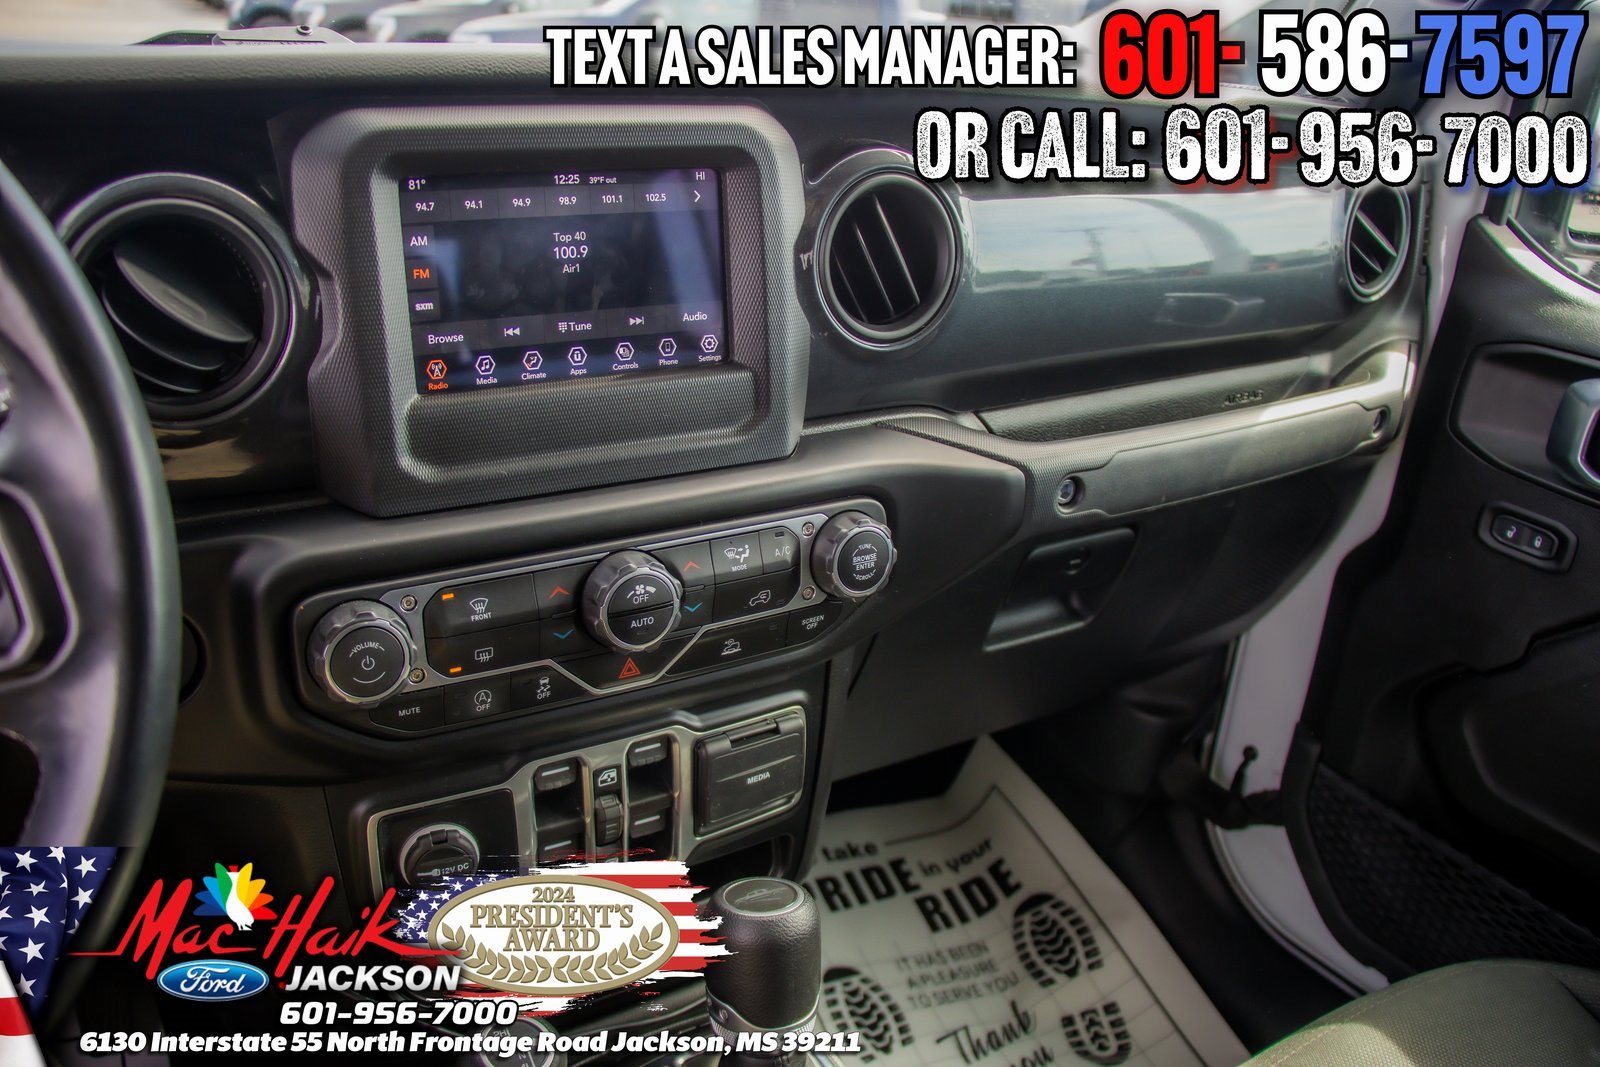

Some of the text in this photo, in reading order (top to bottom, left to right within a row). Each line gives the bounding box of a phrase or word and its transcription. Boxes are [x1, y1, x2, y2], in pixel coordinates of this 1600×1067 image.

[553, 174, 580, 185] 12:25
[605, 176, 617, 184] out
[695, 171, 706, 181] HI
[512, 198, 531, 208] 94.9
[558, 196, 577, 206] 98.9
[602, 194, 623, 204] 101.1
[645, 193, 666, 203] 102.5
[415, 202, 434, 212] 94.7
[464, 200, 483, 210] 94.1
[410, 236, 428, 247] AM
[553, 231, 586, 244] Top 40
[553, 246, 588, 259] 100.9
[562, 263, 580, 274] Air1
[413, 269, 430, 279] FM
[415, 302, 434, 311] sxm
[683, 311, 708, 322] Audio
[568, 321, 592, 332] Tune
[428, 333, 464, 345] Browse
[659, 357, 678, 366] Phone
[698, 353, 722, 363] Settings
[612, 361, 639, 371] Controls
[521, 371, 546, 380] Climate
[570, 367, 587, 376] Apps
[476, 376, 497, 385] Media
[428, 382, 448, 391] Radio
[775, 545, 791, 557] A/C
[852, 552, 877, 563] BROWSE
[731, 563, 748, 572] MODE
[856, 561, 875, 571] ENTER
[855, 572, 875, 581] SCROLL
[632, 593, 649, 605] OFF
[471, 612, 492, 622] FRONT
[802, 614, 825, 626] SCREEN
[630, 616, 655, 629] AUTO
[806, 621, 818, 631] OFF
[352, 641, 380, 653] VOLUME
[536, 690, 551, 700] OFF
[398, 706, 421, 717] MUTE
[476, 703, 491, 712] OFF
[746, 771, 771, 786] MEDIA
[821, 841, 879, 862] take
[442, 862, 470, 875] 12V DC
[802, 836, 994, 913] RIDE in your
[914, 858, 1023, 934] RIDE
[932, 983, 984, 1005] SERVE
[984, 971, 1020, 993] YOU
[936, 999, 1038, 1066] Thank
[1011, 1045, 1056, 1067] ou
